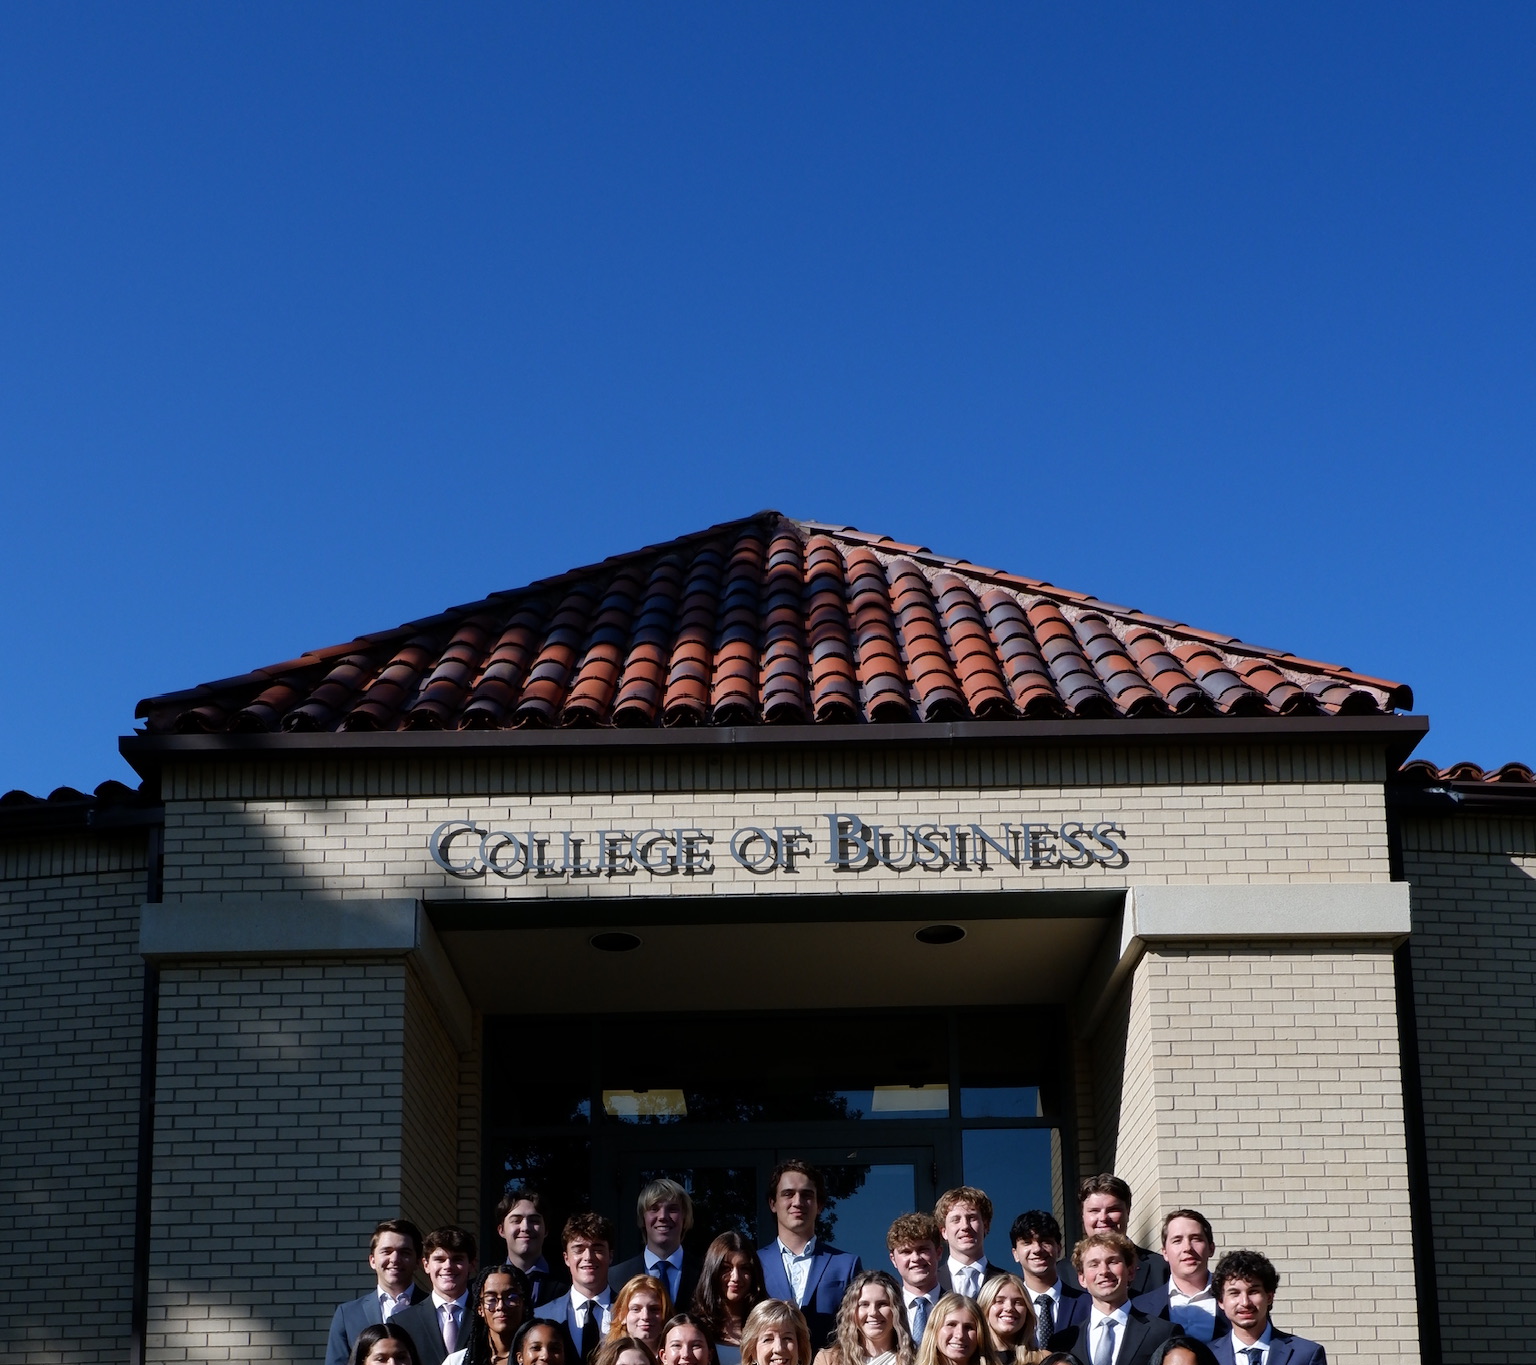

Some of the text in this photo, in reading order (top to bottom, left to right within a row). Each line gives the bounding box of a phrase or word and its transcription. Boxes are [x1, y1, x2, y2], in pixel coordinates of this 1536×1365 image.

[429, 813, 1120, 871] COLLEGE OF BUSINESS
